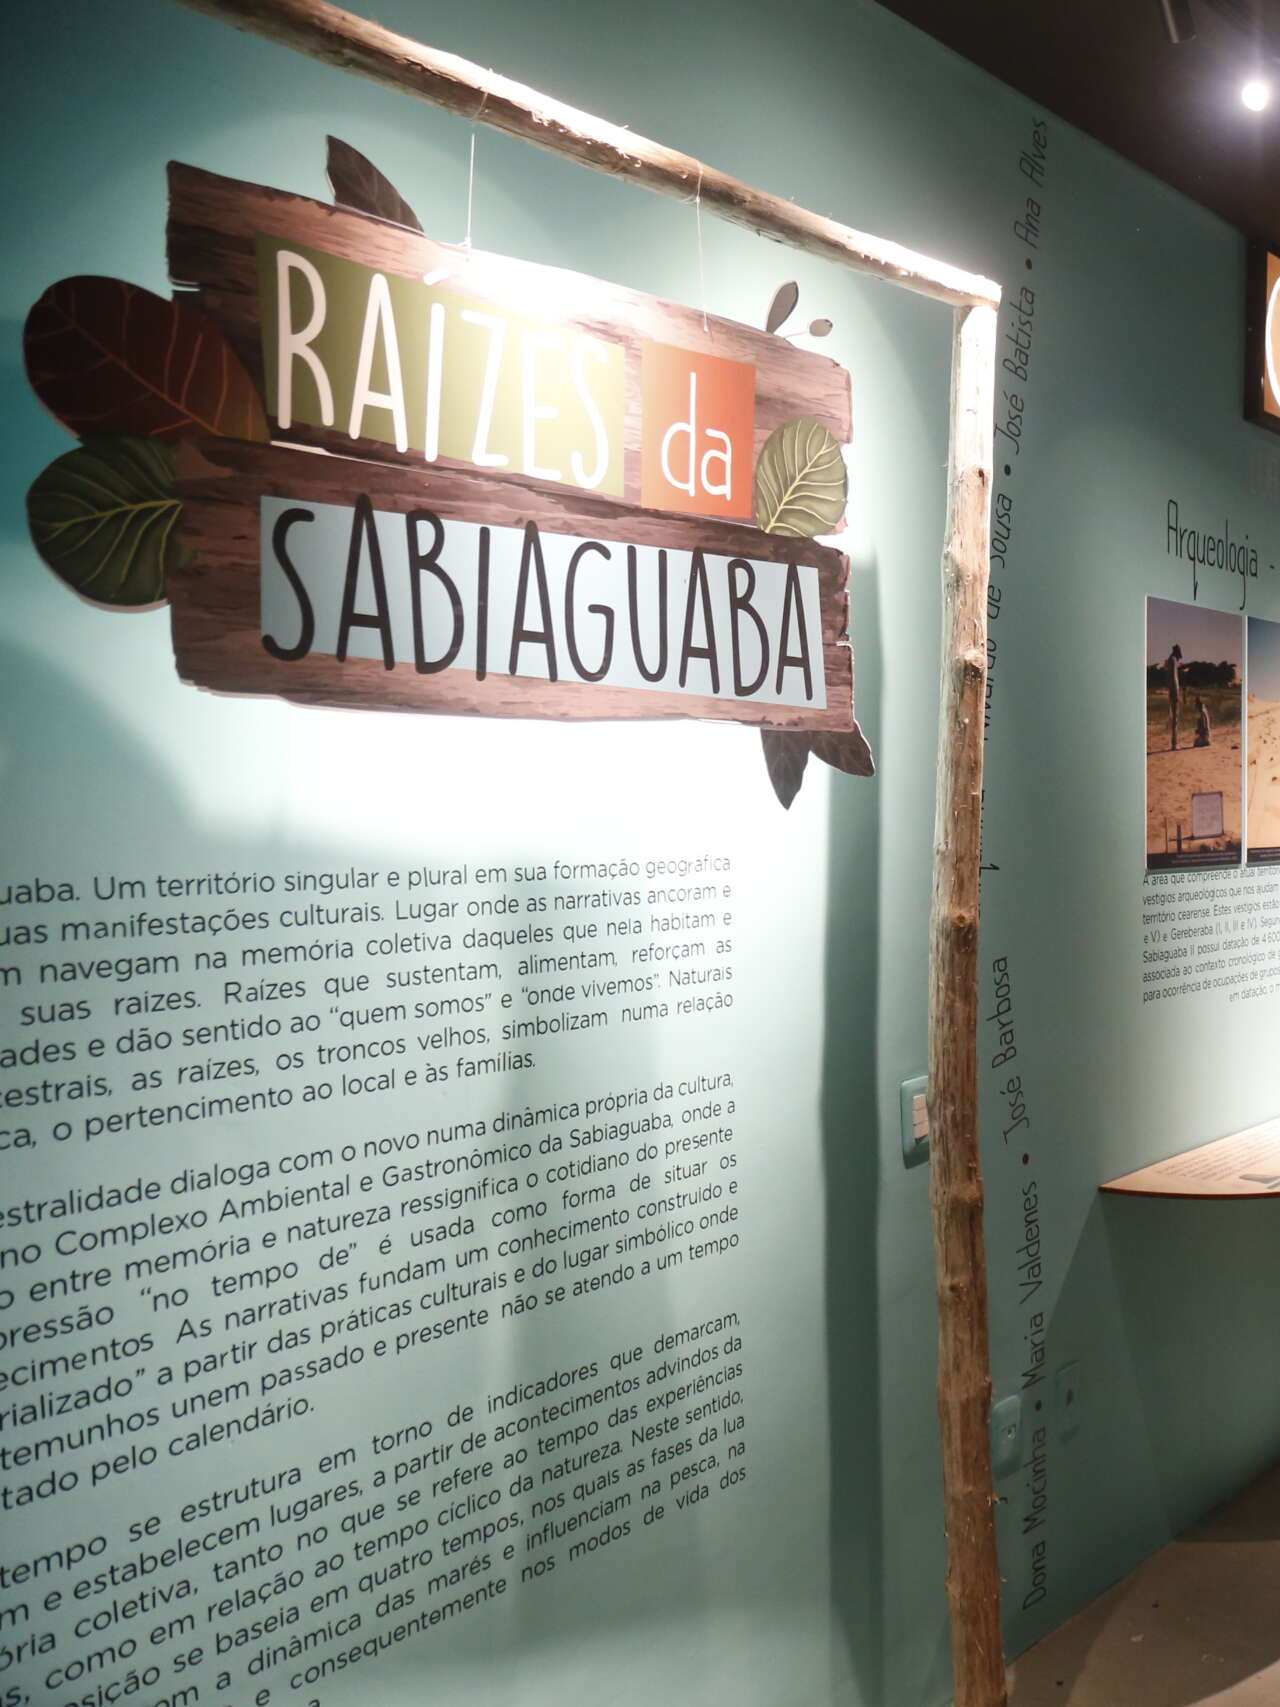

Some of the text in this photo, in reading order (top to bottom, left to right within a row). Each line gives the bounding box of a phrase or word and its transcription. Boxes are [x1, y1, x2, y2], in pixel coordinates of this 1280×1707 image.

[1014, 116, 1047, 248] Ana Alves
[276, 249, 733, 502] RAÍZES da
[994, 286, 1037, 455] José Batista
[261, 494, 814, 701] SABIAGUABA
[1167, 498, 1259, 610] Arqueologia
[62, 909, 269, 941] manifestações
[280, 904, 383, 927] culturais.
[396, 900, 458, 922] Lugar
[467, 895, 519, 916] onde
[527, 897, 546, 912] as
[555, 891, 640, 909] narrativas
[647, 885, 716, 905] ancoram
[94, 876, 146, 901] Um
[157, 872, 275, 897] território
[285, 867, 379, 894] singular
[387, 871, 400, 887] e
[408, 864, 467, 890] plural
[475, 868, 507, 883] em
[514, 866, 547, 882] sua
[553, 859, 640, 880] formação
[21, 1001, 91, 1026] suas
[225, 979, 305, 1004] Raízes
[325, 975, 369, 997] que
[387, 963, 502, 988] sustentam,
[519, 952, 618, 975] alimentam,
[632, 941, 704, 962] reforçam
[716, 938, 732, 954] as
[88, 1039, 104, 1057] e
[117, 1028, 172, 1053] dão
[183, 1015, 281, 1046] sentido
[291, 1015, 320, 1033] ao
[501, 994, 512, 1008] e
[670, 967, 732, 985] Naturais
[987, 954, 1030, 1144] José Barbosa
[53, 1122, 72, 1141] o
[86, 1088, 292, 1141] pertencimento
[303, 1083, 332, 1102] ao
[343, 1069, 394, 1095] local
[405, 1071, 416, 1085] e
[426, 1064, 448, 1083] às
[457, 1052, 535, 1077] famílias.
[56, 1211, 207, 1255] Complexo
[220, 1174, 349, 1222] Ambiental
[360, 1176, 372, 1191] e
[383, 1144, 531, 1186] Gastronômico
[539, 1134, 562, 1154] da
[570, 1113, 673, 1147] Sabiaguaba,
[682, 1101, 721, 1123] onde
[728, 1101, 735, 1113] a
[212, 1262, 298, 1296] tempo
[379, 1239, 391, 1255] é
[411, 1216, 474, 1246] usada
[492, 1202, 547, 1226] como
[562, 1185, 615, 1208] forma
[630, 1173, 650, 1192] de
[665, 1162, 707, 1183] situar
[720, 1155, 736, 1169] os
[1016, 1180, 1046, 1390] Maria Valdenes
[0, 1313, 740, 1588] tempo se estrutura em torno de indicadores que demarcam,
[1020, 1425, 1048, 1610] Dona Mocinha
[46, 1639, 136, 1689] como
[150, 1615, 194, 1644] em
[208, 1570, 303, 1622] relação
[315, 1554, 344, 1577] ao
[354, 1520, 428, 1560] tempo
[438, 1490, 501, 1526] cíclico
[510, 1475, 533, 1496] da
[632, 1417, 679, 1447] Neste
[686, 1391, 743, 1424] sentido,
[256, 1468, 745, 1707] e consequentemente nos modos de vida dos
